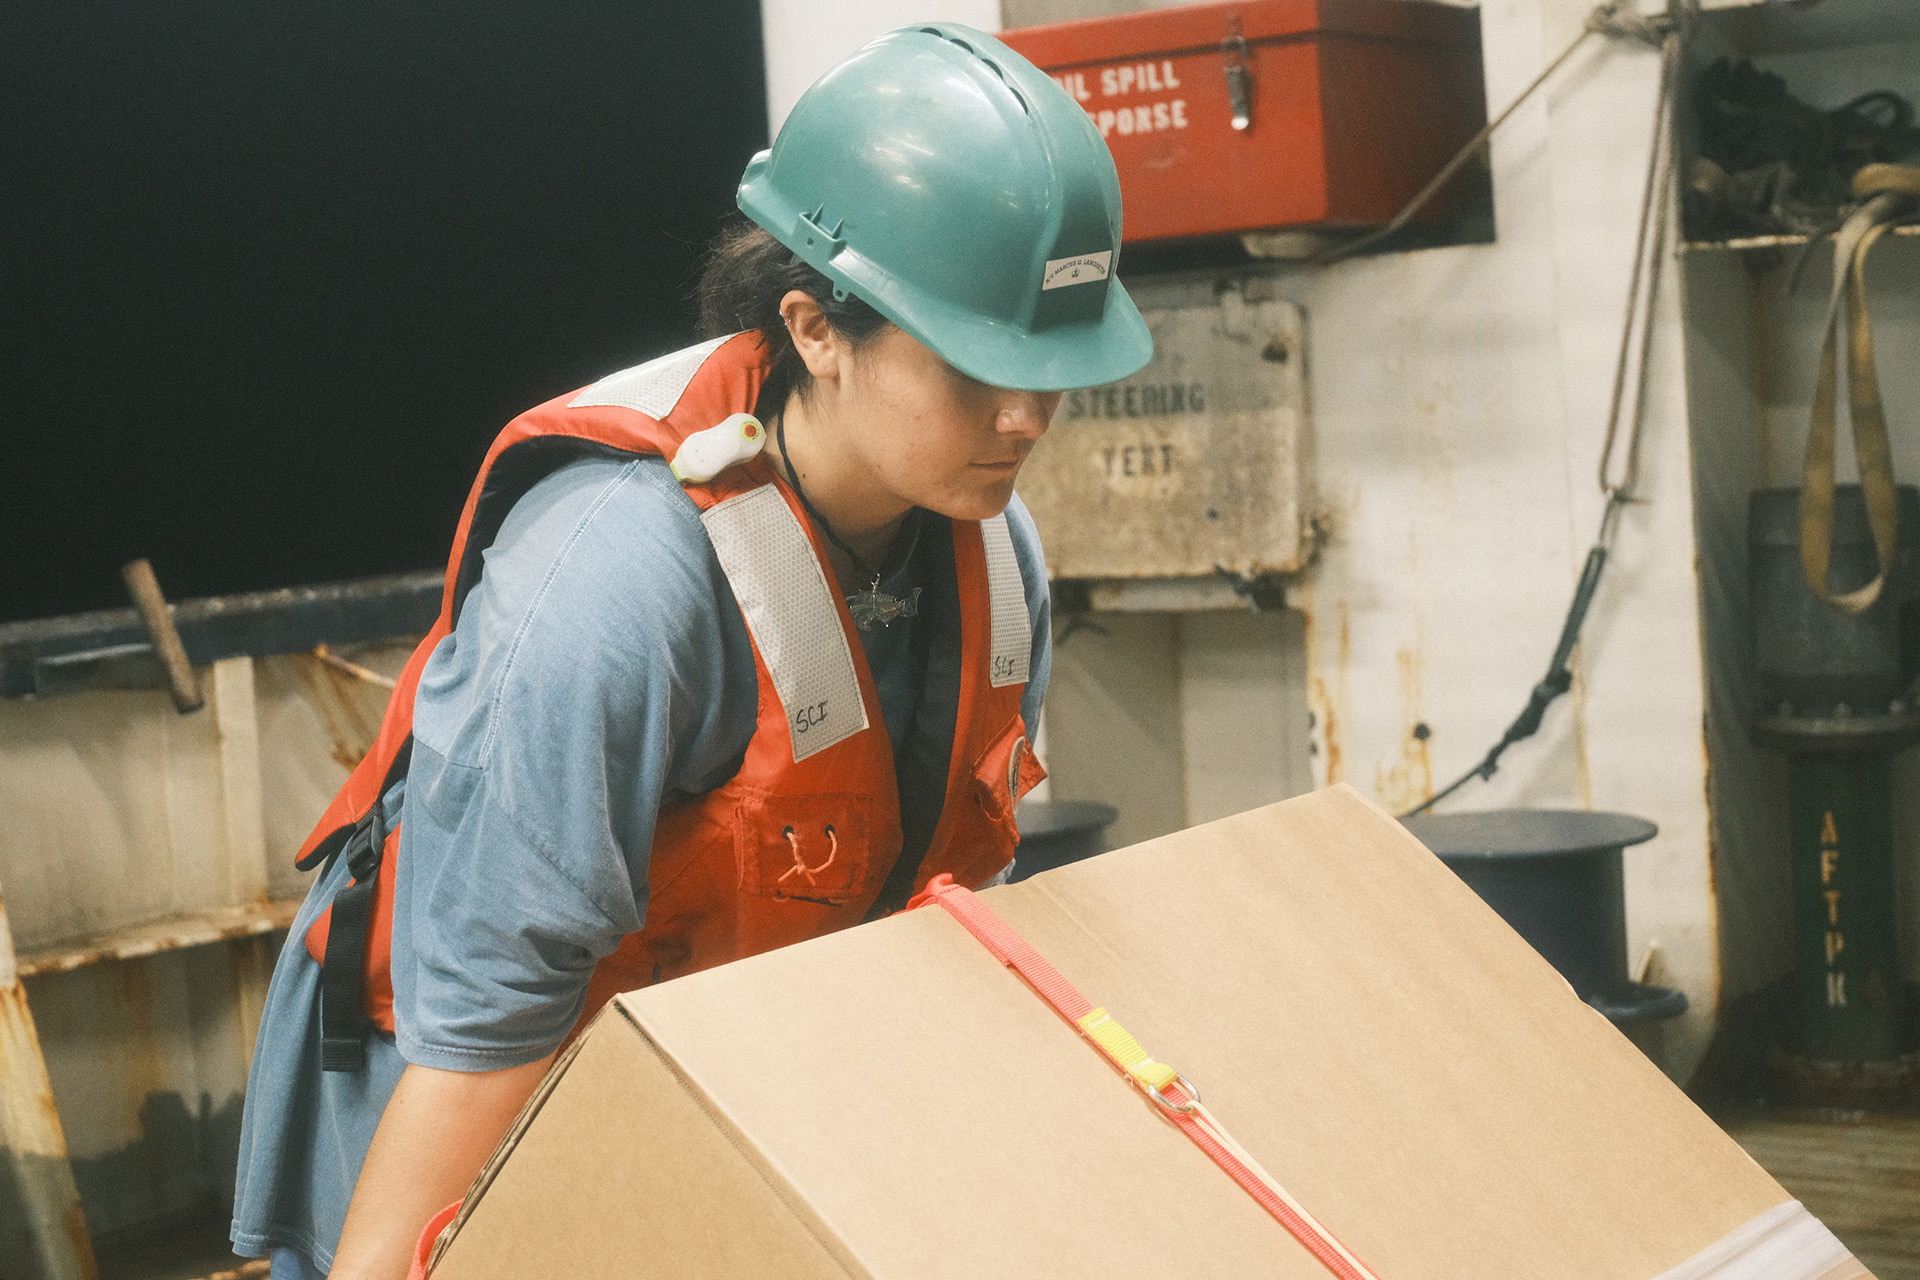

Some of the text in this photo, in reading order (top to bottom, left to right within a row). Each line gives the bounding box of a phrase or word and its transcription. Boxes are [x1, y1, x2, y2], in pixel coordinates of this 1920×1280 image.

[1101, 60, 1181, 96] SPILL
[1088, 99, 1188, 138] PONSE
[1054, 260, 1077, 275] MARCUS
[1084, 259, 1106, 275] LANGSETH
[1067, 383, 1206, 420] STEERING
[796, 699, 829, 733] SCI
